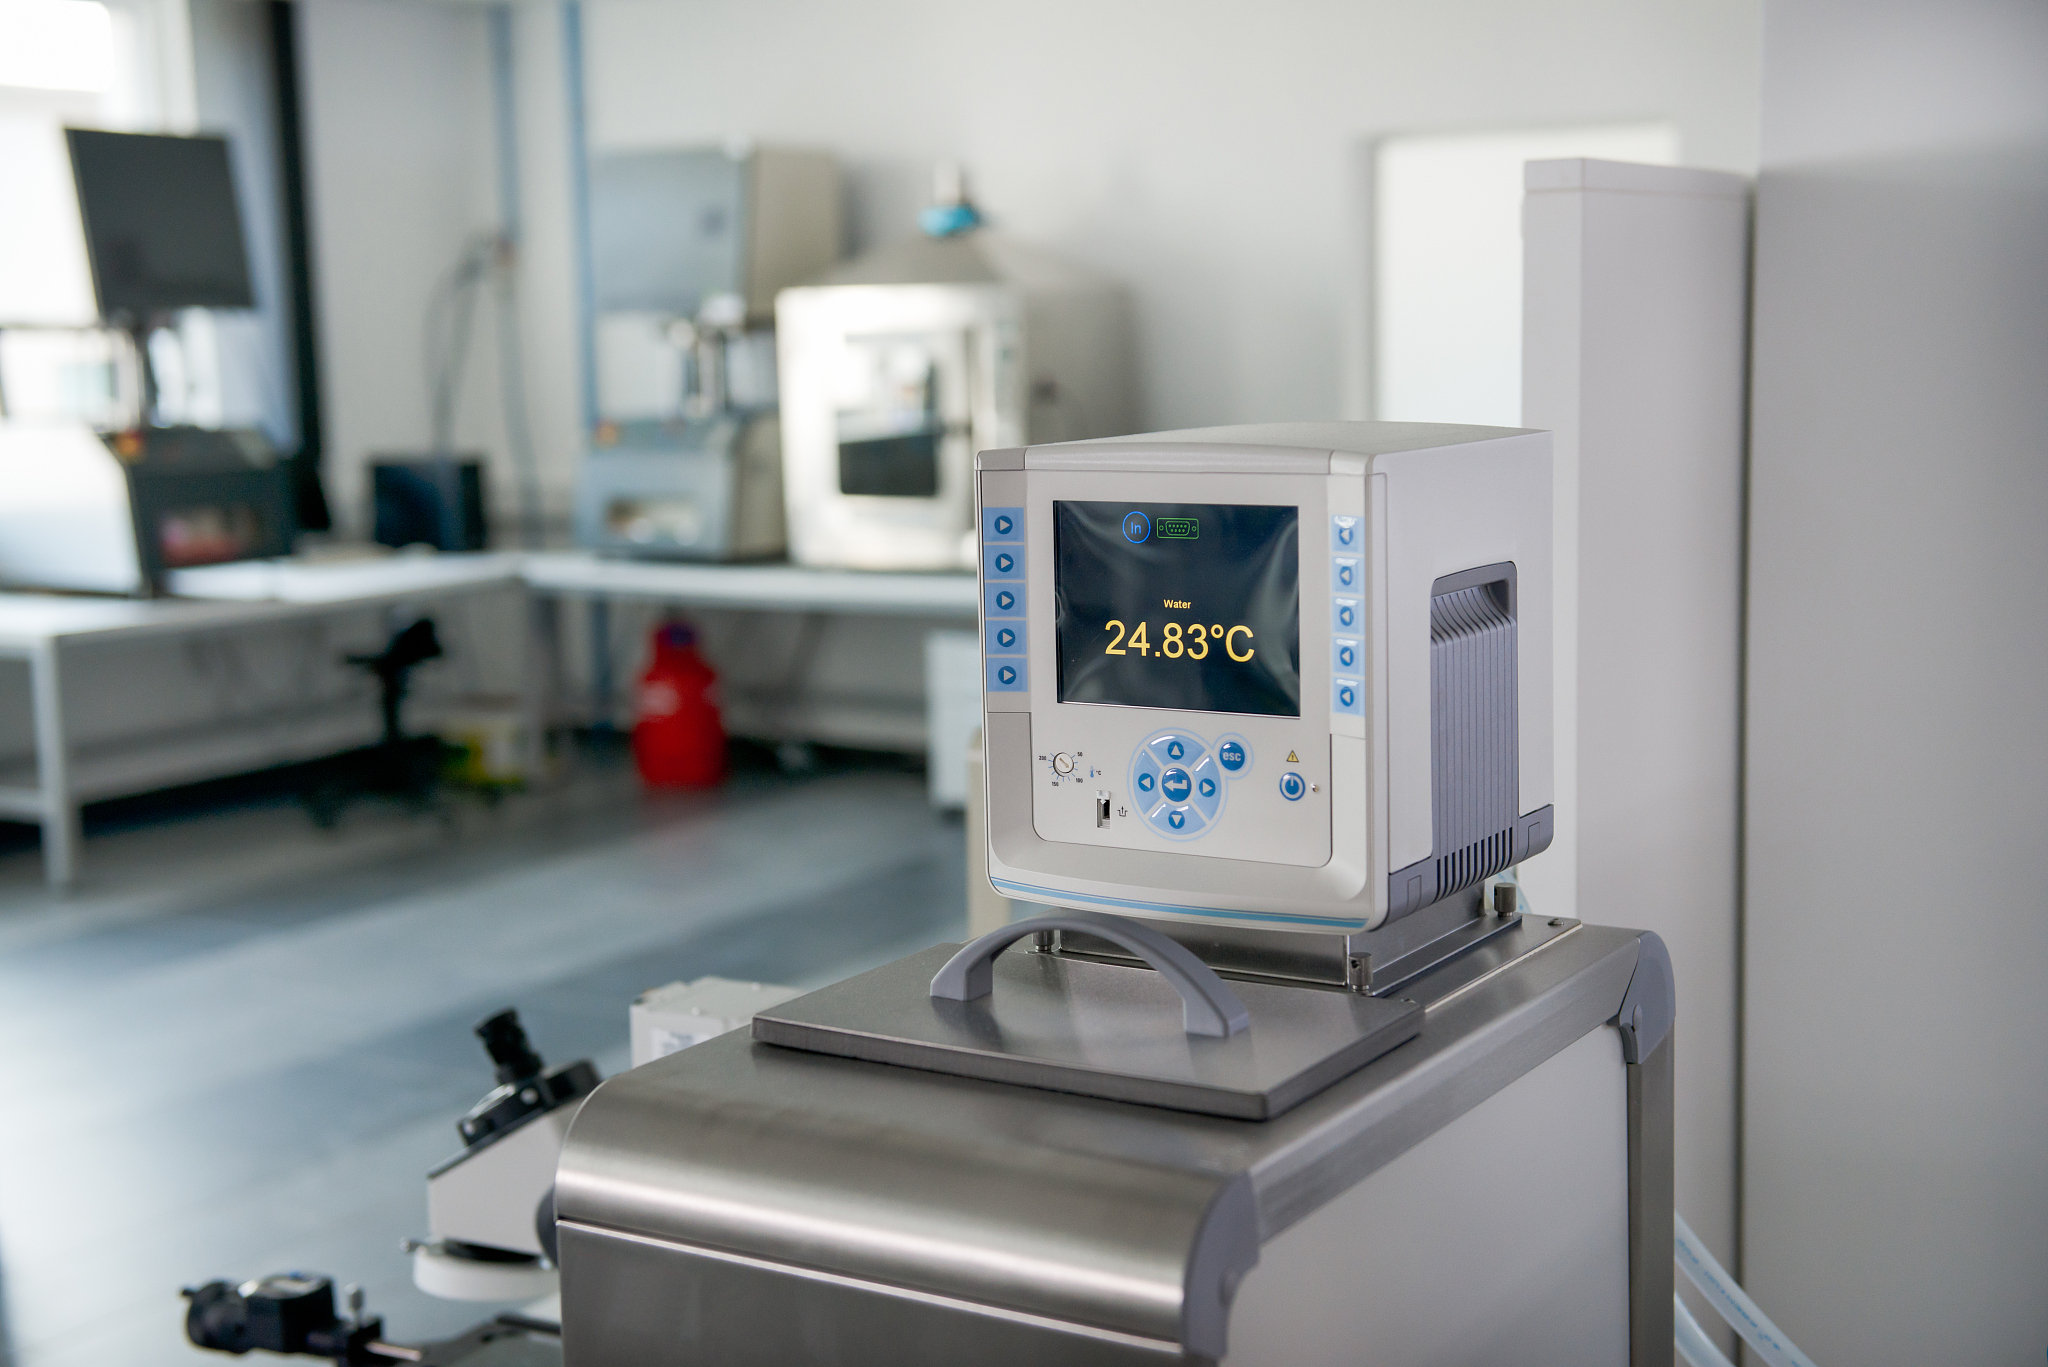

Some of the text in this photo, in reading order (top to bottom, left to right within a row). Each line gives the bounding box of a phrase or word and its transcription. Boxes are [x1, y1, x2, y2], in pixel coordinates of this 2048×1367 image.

[1163, 599, 1191, 609] Water
[1105, 620, 1255, 662] 24.83°C
[1222, 751, 1242, 762] esc
